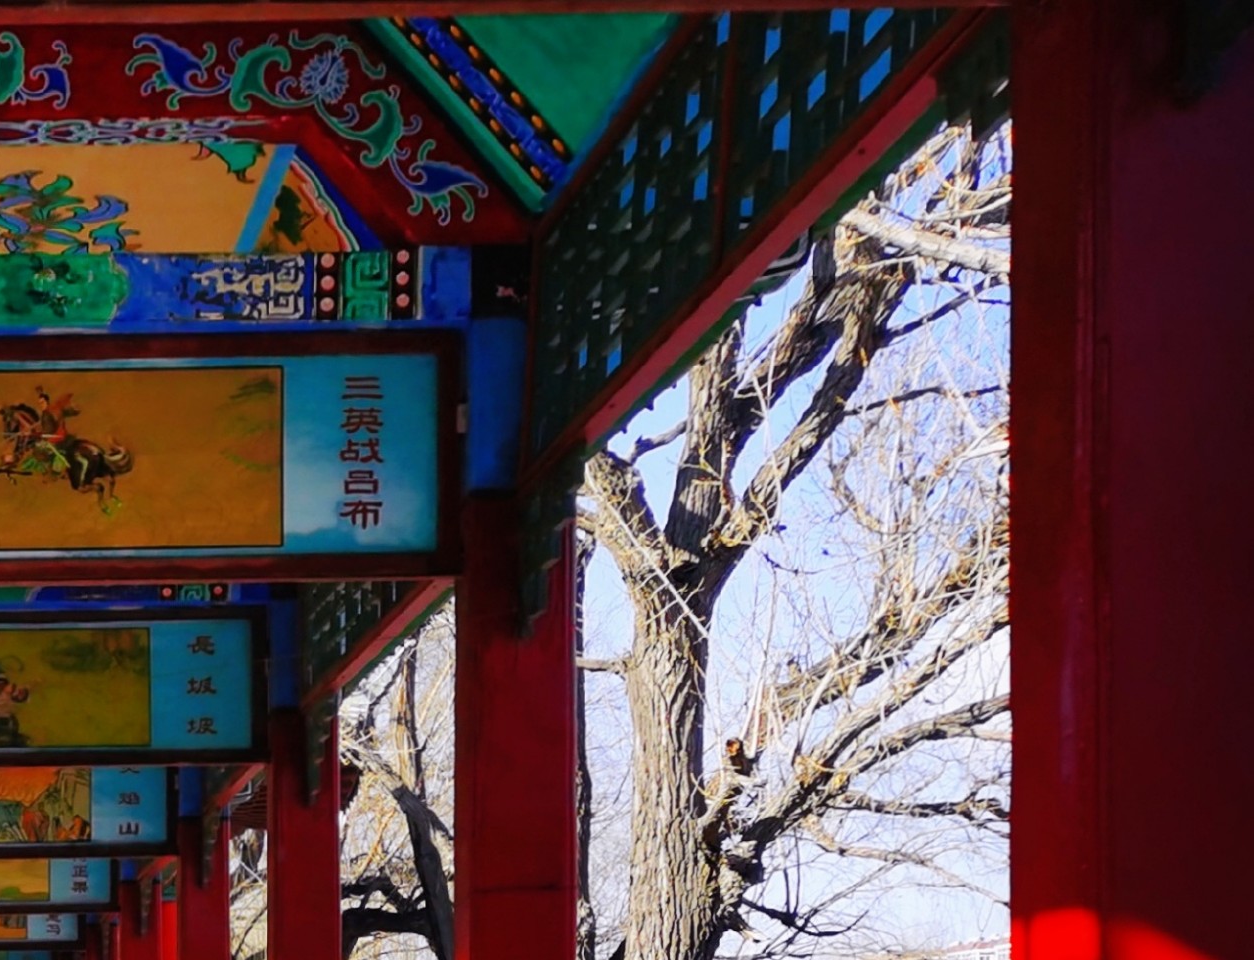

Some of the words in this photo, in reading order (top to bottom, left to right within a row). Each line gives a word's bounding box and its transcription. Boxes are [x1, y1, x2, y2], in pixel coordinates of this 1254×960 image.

[339, 376, 384, 530] 三英战吕布
